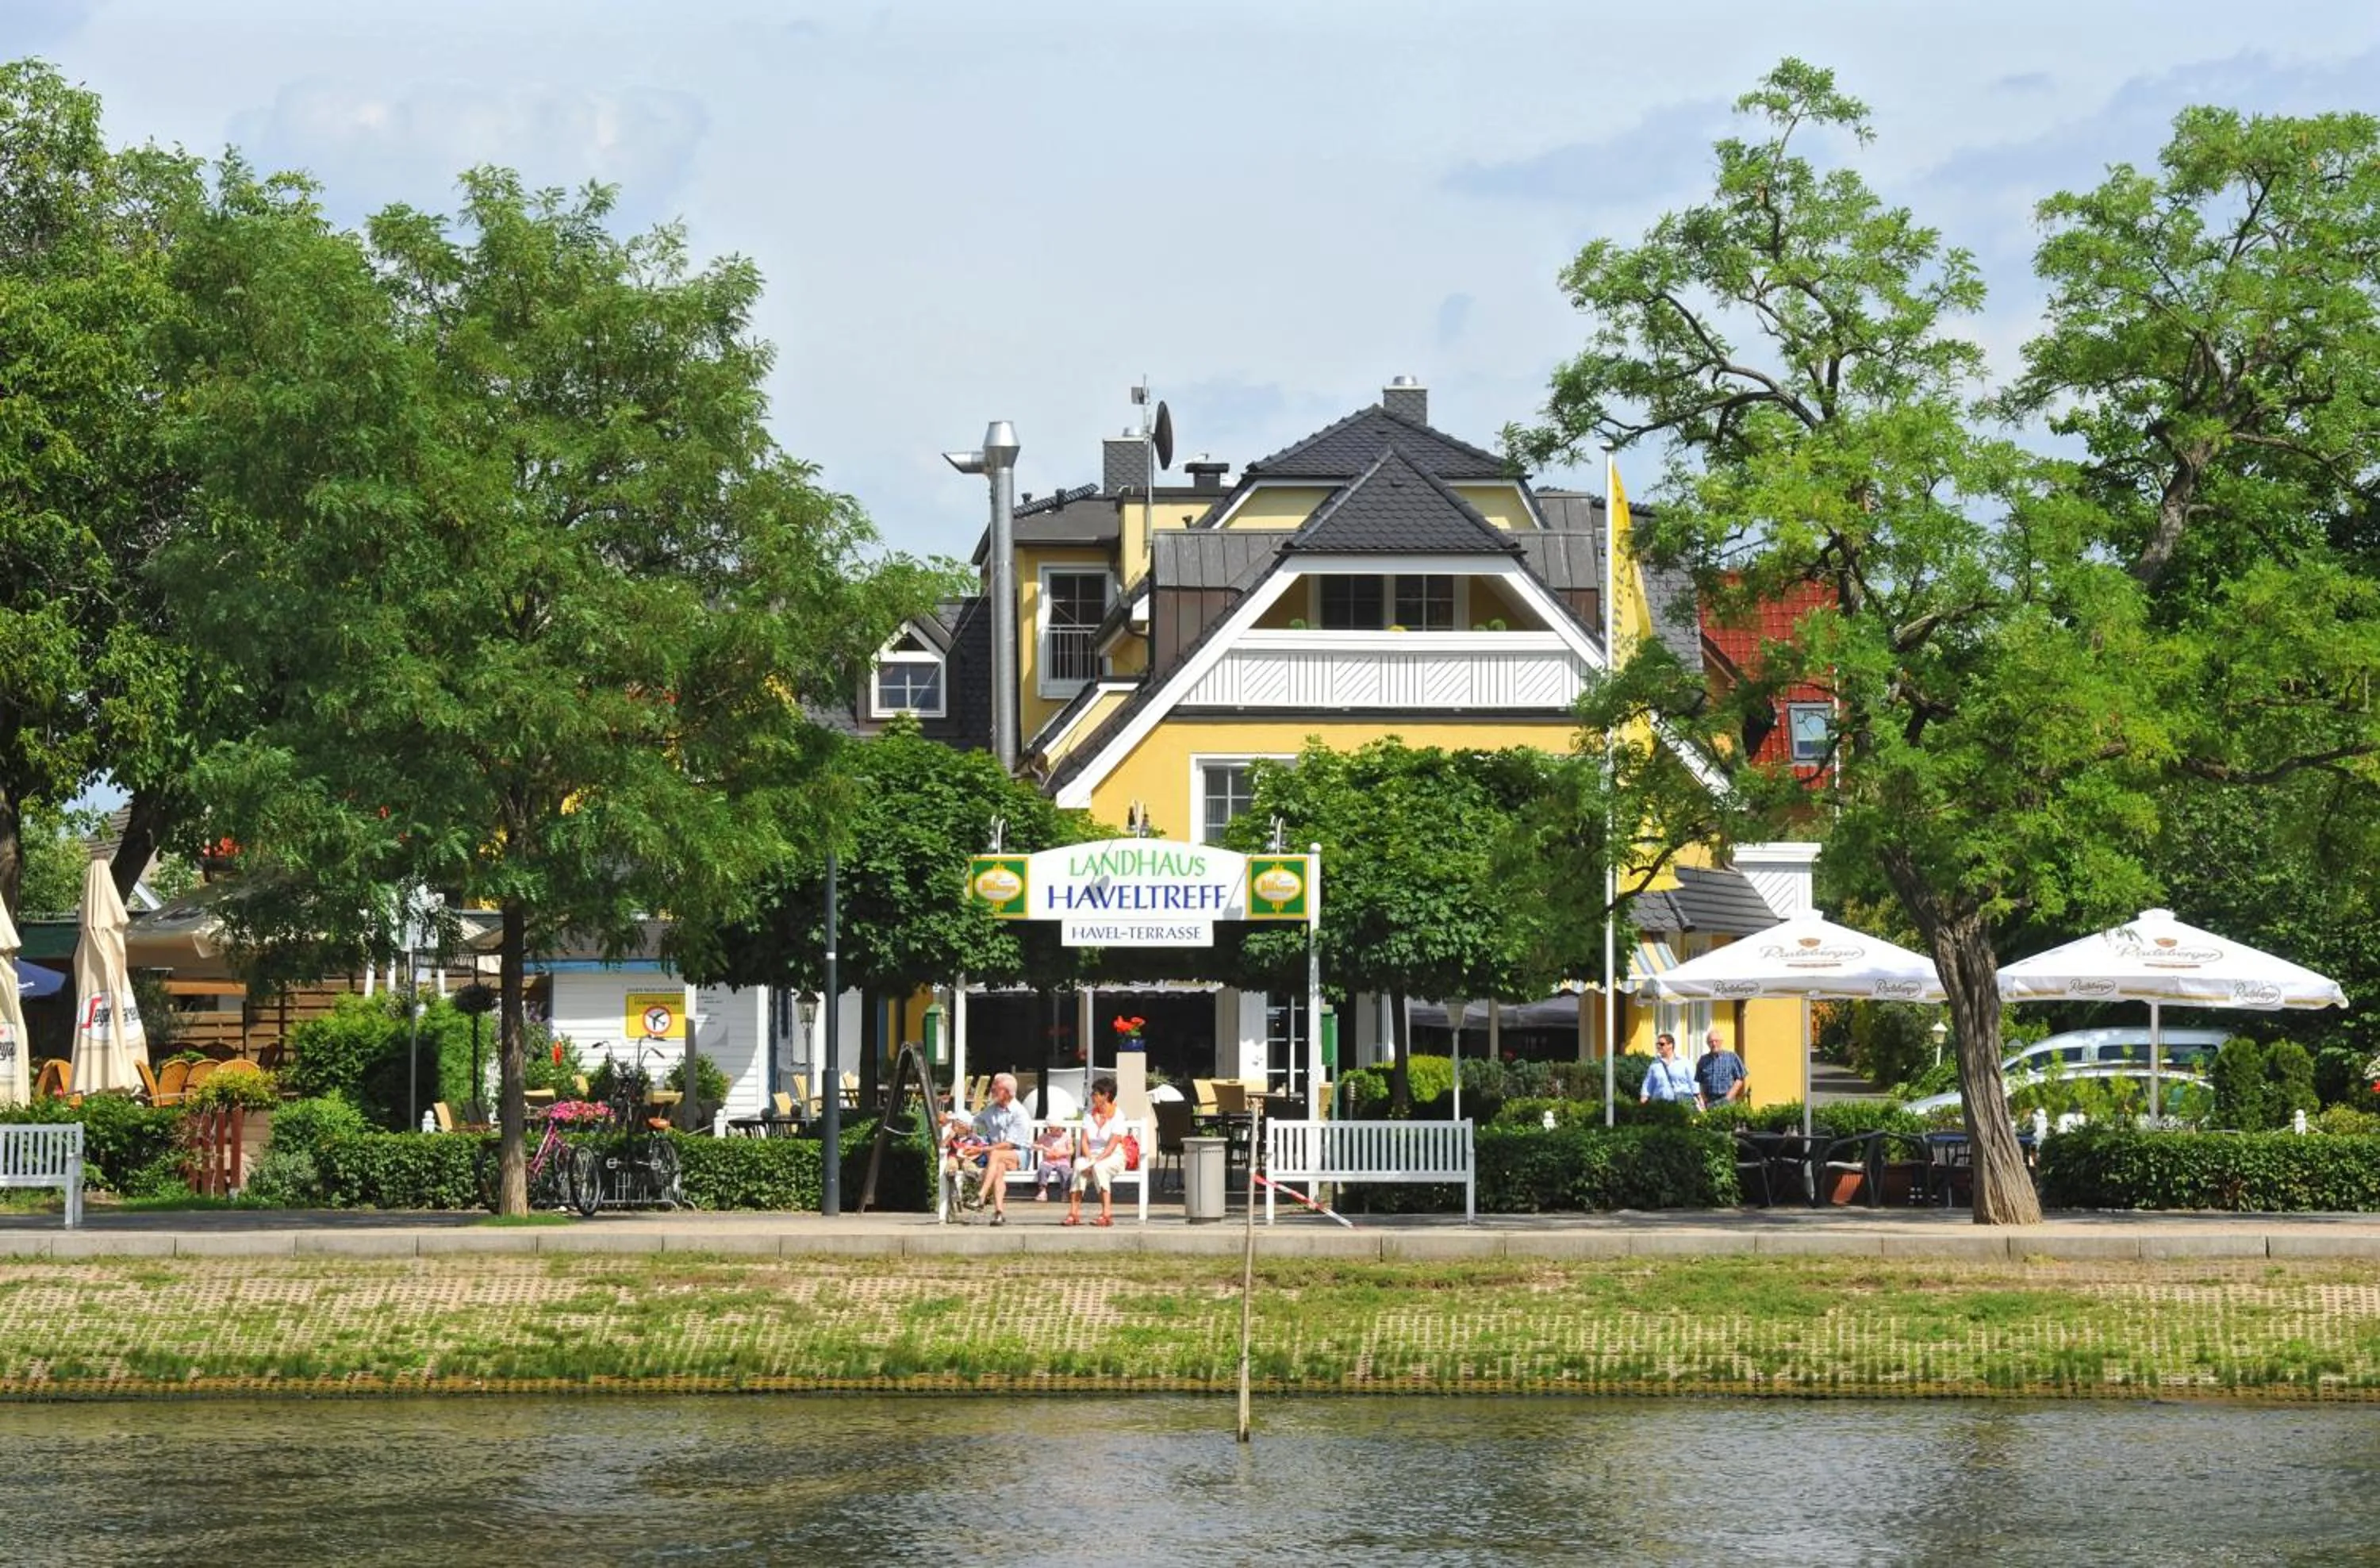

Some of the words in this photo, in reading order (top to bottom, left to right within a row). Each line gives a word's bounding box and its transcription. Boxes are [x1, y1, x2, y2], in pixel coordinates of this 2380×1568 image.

[1069, 849, 1205, 877] LANDHAUS
[1047, 884, 1227, 910] HAVELTREFF
[1071, 925, 1201, 940] HAVEL-TERRASSE
